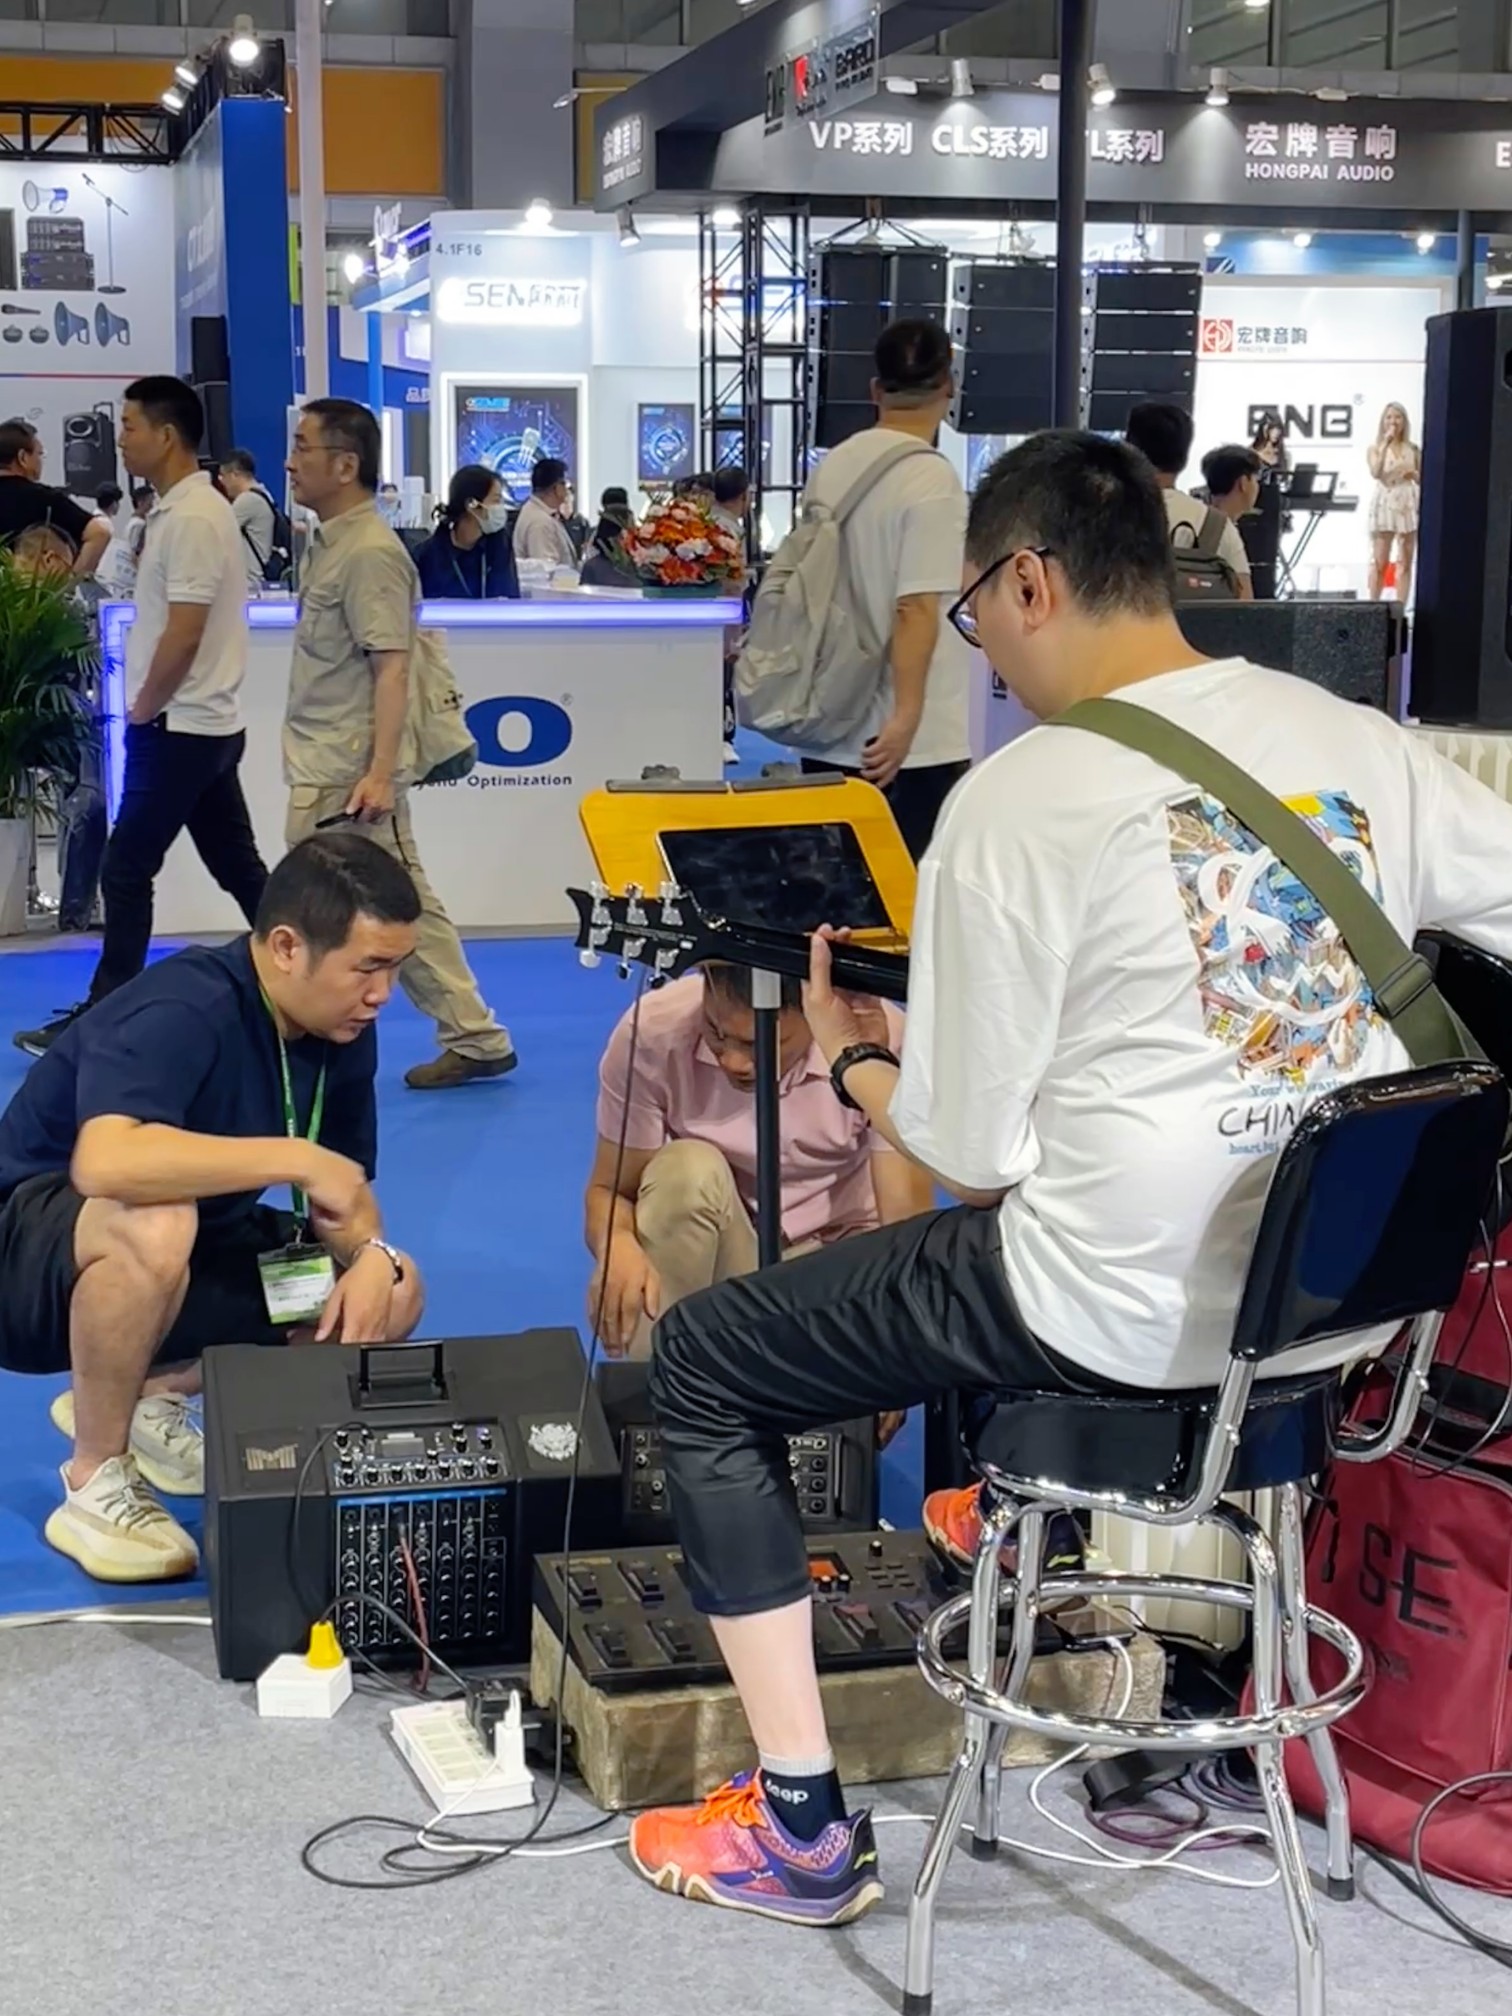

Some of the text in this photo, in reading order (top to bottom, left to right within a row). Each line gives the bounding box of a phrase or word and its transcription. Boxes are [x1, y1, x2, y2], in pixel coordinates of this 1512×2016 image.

[809, 121, 912, 156] VP系列
[931, 125, 1048, 160] CLS系列
[1246, 122, 1397, 160] 宏牌音响
[1246, 163, 1394, 181] HONGPAI AUDIO
[435, 243, 482, 256] 4.1F16
[467, 774, 572, 790] Optimization
[1218, 1102, 1305, 1137] CHIN
